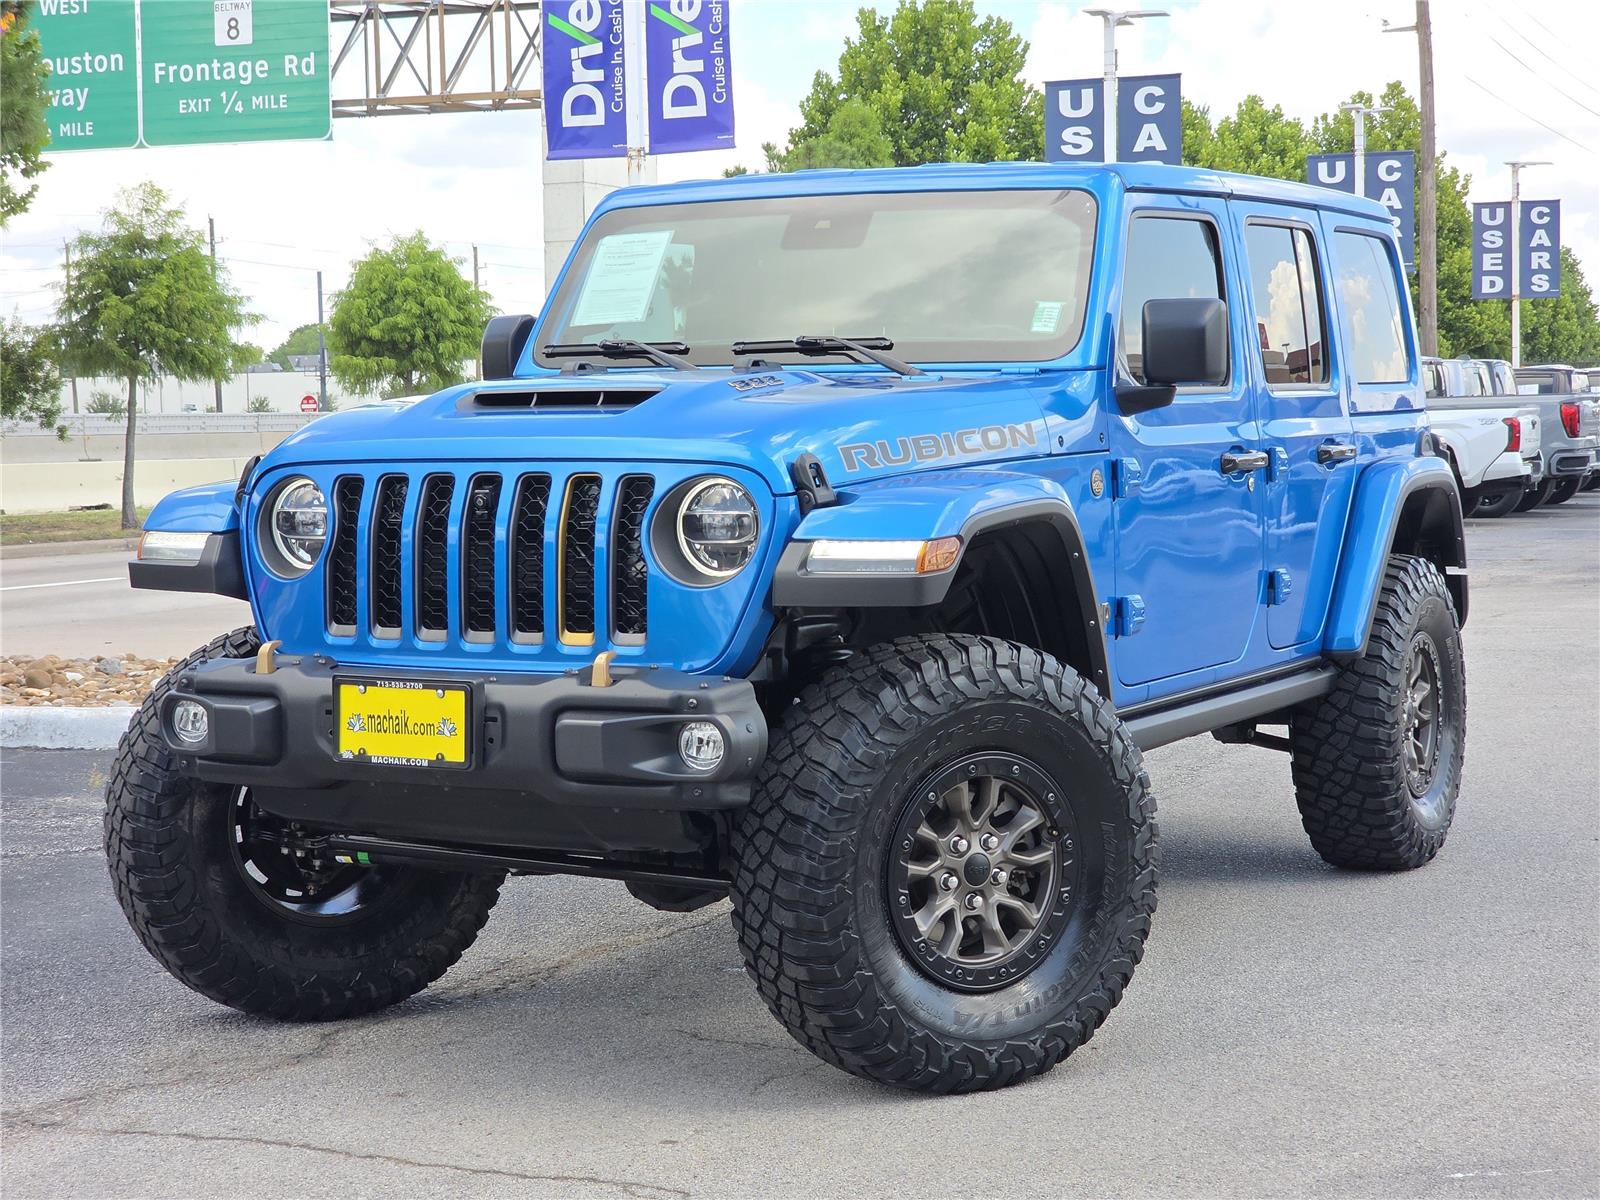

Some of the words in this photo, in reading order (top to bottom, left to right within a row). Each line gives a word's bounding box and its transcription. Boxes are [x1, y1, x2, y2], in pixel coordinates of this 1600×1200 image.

[215, 2, 250, 12] BELTWAY
[708, 0, 723, 34] Cash
[227, 17, 240, 40] 8
[608, 8, 622, 45] Cash
[611, 48, 623, 64] In.
[710, 38, 723, 57] In.
[154, 58, 269, 85] Frontage
[284, 52, 315, 76] Rd
[712, 57, 726, 104] Cruise
[179, 98, 211, 113] EXIT
[252, 94, 288, 110] MILE
[612, 66, 623, 112] Cruise
[60, 122, 93, 137] MILE
[1481, 207, 1504, 294] USED
[1529, 206, 1552, 292] CARS
[839, 422, 1038, 472] RUBICON
[367, 709, 436, 737] machaik.com
[371, 756, 429, 767] MACHAIK.COM
